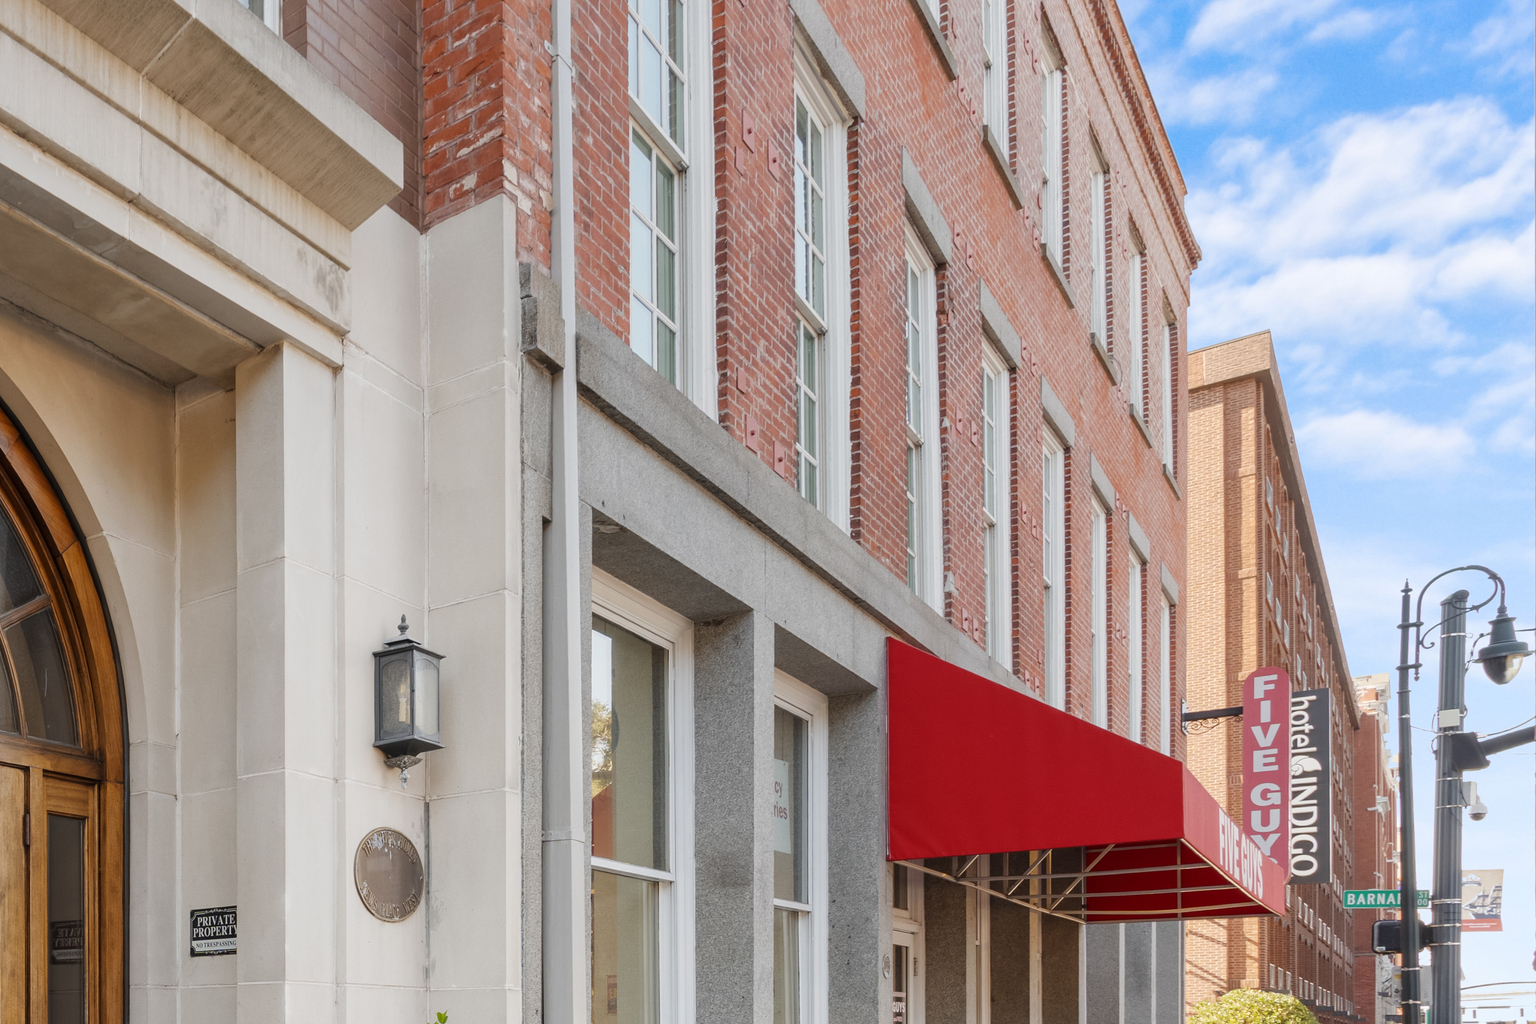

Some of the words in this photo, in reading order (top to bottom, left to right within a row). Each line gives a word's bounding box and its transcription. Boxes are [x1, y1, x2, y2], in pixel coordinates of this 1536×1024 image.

[1250, 674, 1281, 773] FIVE
[1291, 695, 1317, 755] hotel
[1250, 782, 1281, 864] GUY
[1291, 776, 1318, 877] INDIGO
[1219, 807, 1240, 881] FIVE
[1241, 833, 1263, 900] GUYS
[1347, 893, 1401, 905] BARNA
[193, 924, 237, 938] PROPERTY
[197, 913, 236, 927] PRIVATE
[204, 940, 237, 948] TRESPASSING
[892, 1001, 905, 1013] GUYS
